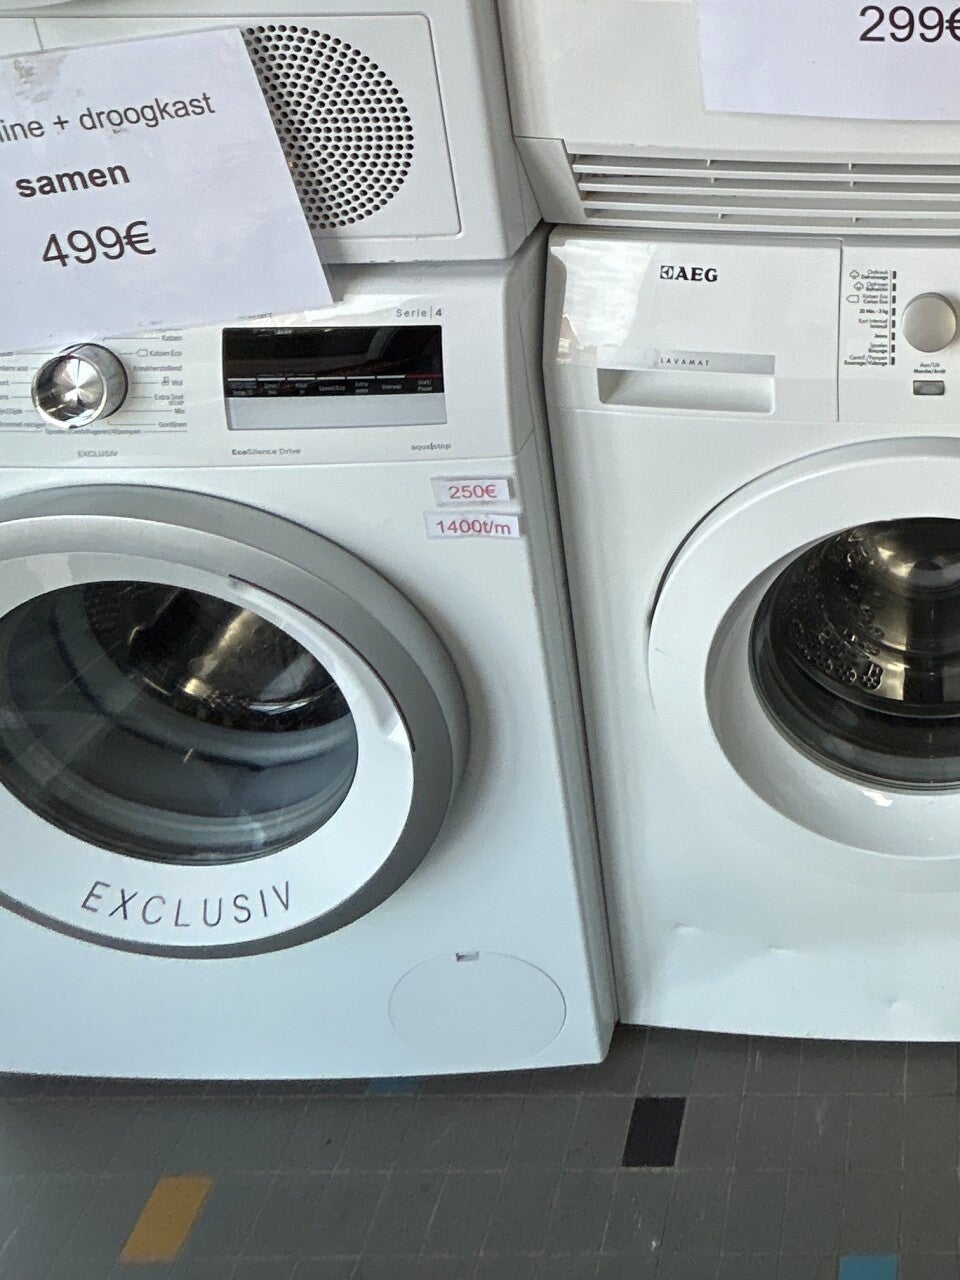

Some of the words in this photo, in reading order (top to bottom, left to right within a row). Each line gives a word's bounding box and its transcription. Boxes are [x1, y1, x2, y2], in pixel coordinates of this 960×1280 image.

[53, 115, 69, 131] +
[79, 92, 215, 132] droogkast
[15, 164, 130, 198] samen
[42, 220, 156, 267] 499€
[674, 267, 718, 282] AEG
[396, 308, 427, 318] Serie
[435, 308, 442, 317] 4
[661, 357, 710, 366] LAVAMAT
[448, 484, 498, 499] 250€
[436, 515, 511, 535] 1400t/m
[81, 880, 291, 927] EXCLUSIV
